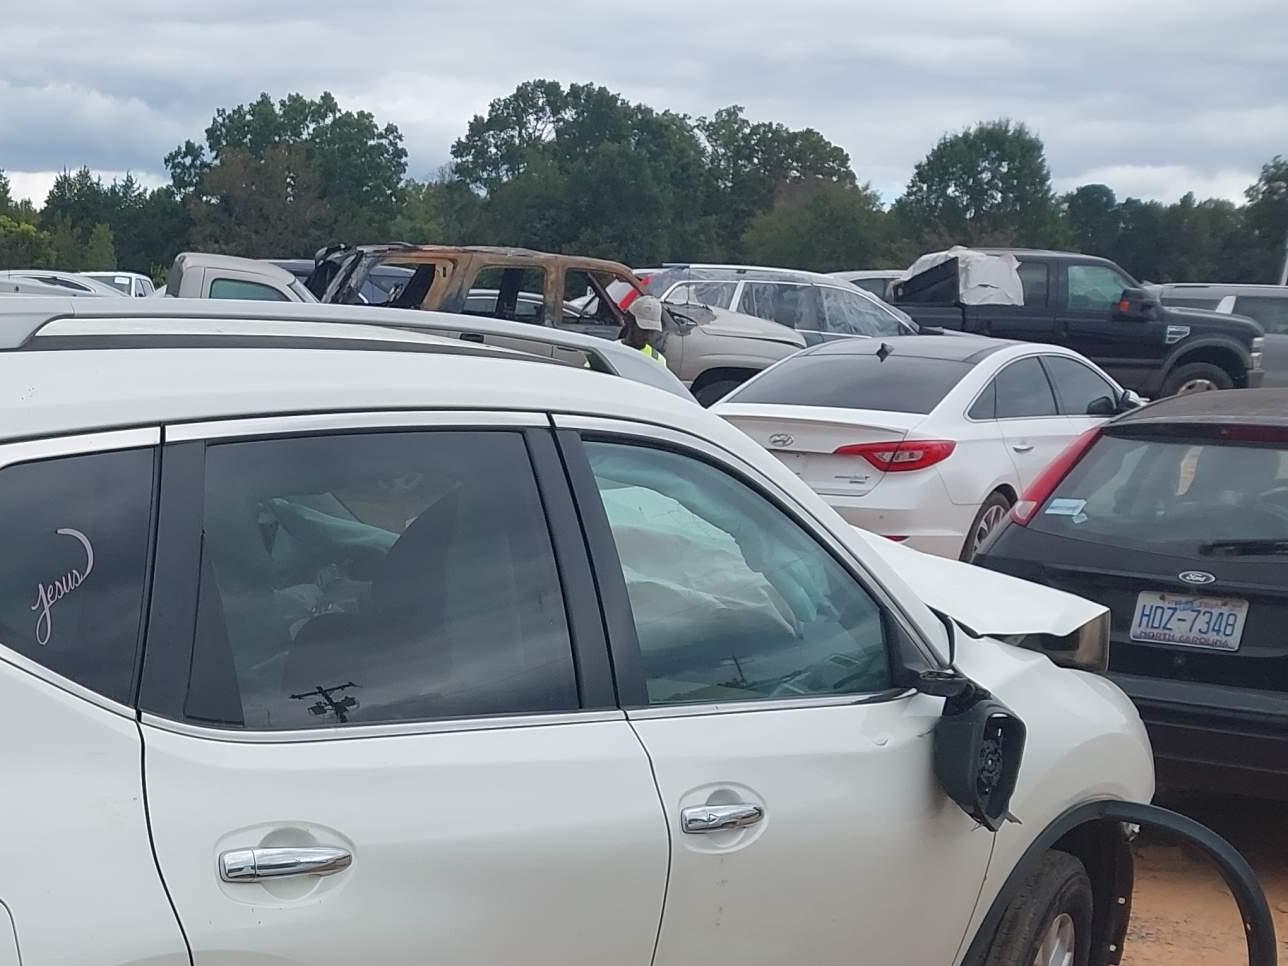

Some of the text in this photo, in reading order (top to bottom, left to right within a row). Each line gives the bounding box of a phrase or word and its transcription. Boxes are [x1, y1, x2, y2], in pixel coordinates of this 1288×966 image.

[32, 528, 93, 645] Jesus
[1139, 630, 1229, 648] NORTH CAROLINA
